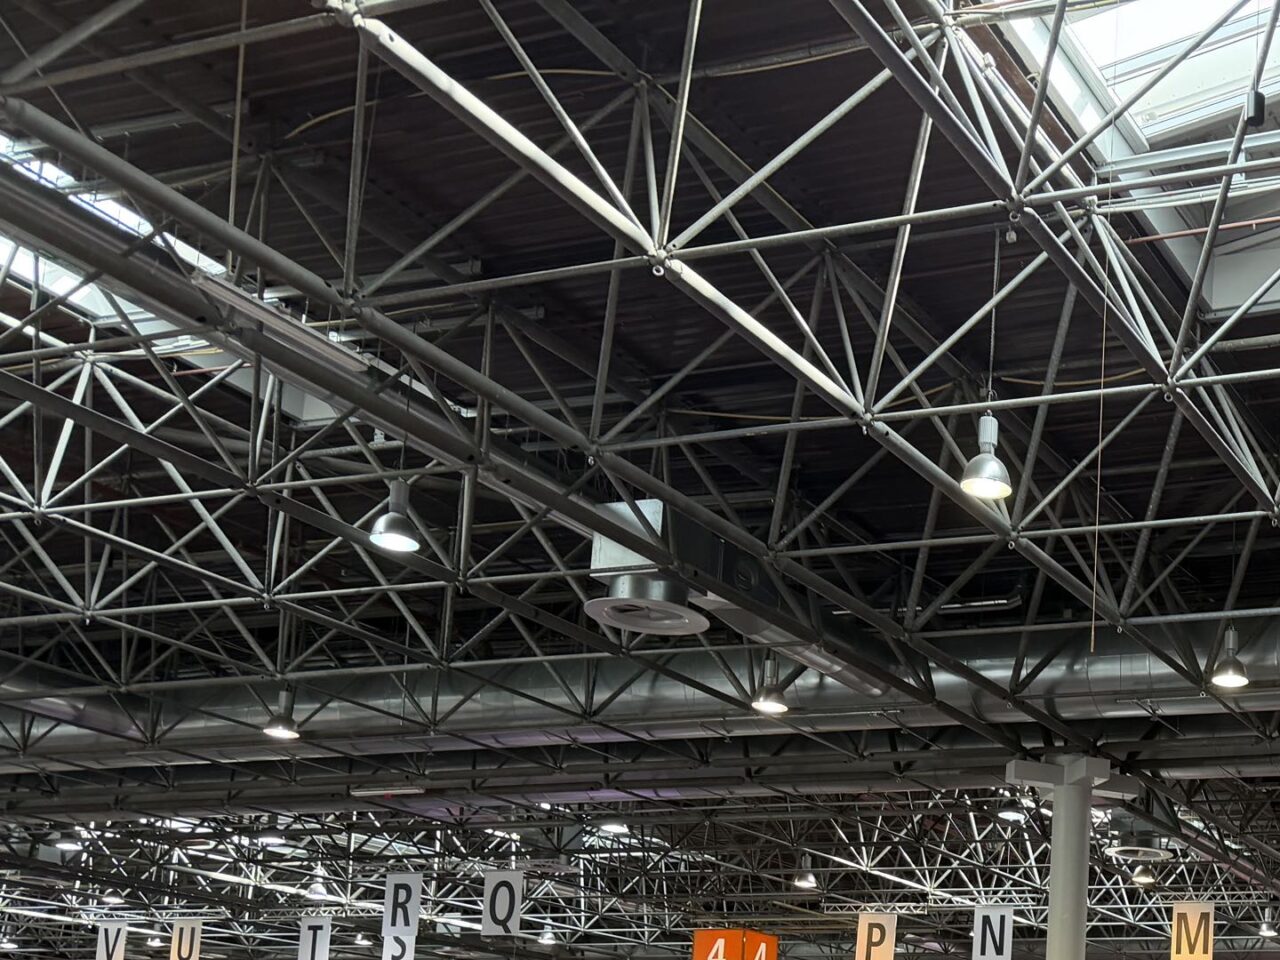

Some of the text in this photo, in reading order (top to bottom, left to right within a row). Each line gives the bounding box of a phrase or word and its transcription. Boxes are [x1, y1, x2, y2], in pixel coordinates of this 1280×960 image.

[390, 883, 413, 928] R
[489, 880, 516, 934] Q
[980, 915, 1005, 957] N
[1175, 912, 1210, 956] M
